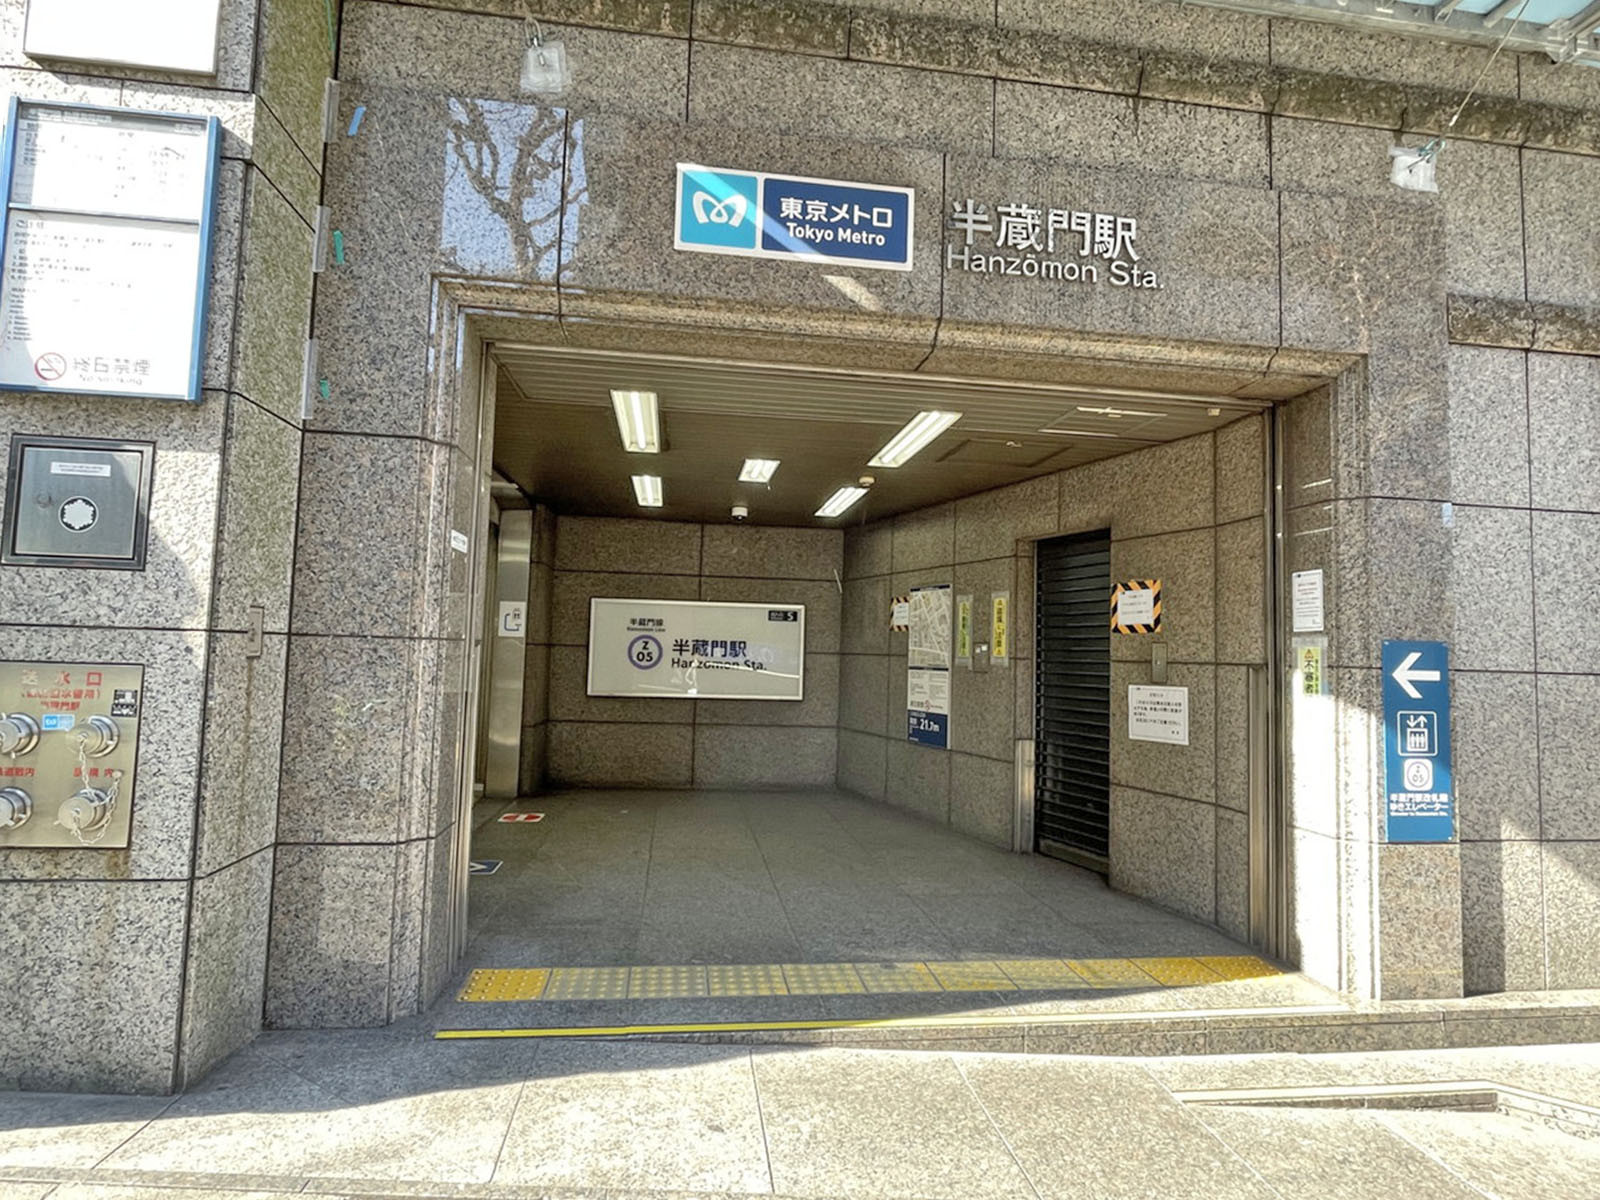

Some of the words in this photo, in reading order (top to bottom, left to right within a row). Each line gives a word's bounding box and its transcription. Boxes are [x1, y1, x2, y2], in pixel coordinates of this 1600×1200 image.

[780, 197, 892, 228] 東京メトロ
[786, 222, 834, 243] Tokyo
[837, 227, 886, 246] Metro
[947, 199, 1141, 262] 半蔵門駅
[1110, 260, 1165, 289] Sta.
[636, 651, 654, 663] 05
[642, 640, 650, 651] Z
[672, 639, 747, 658] 半蔵門駅
